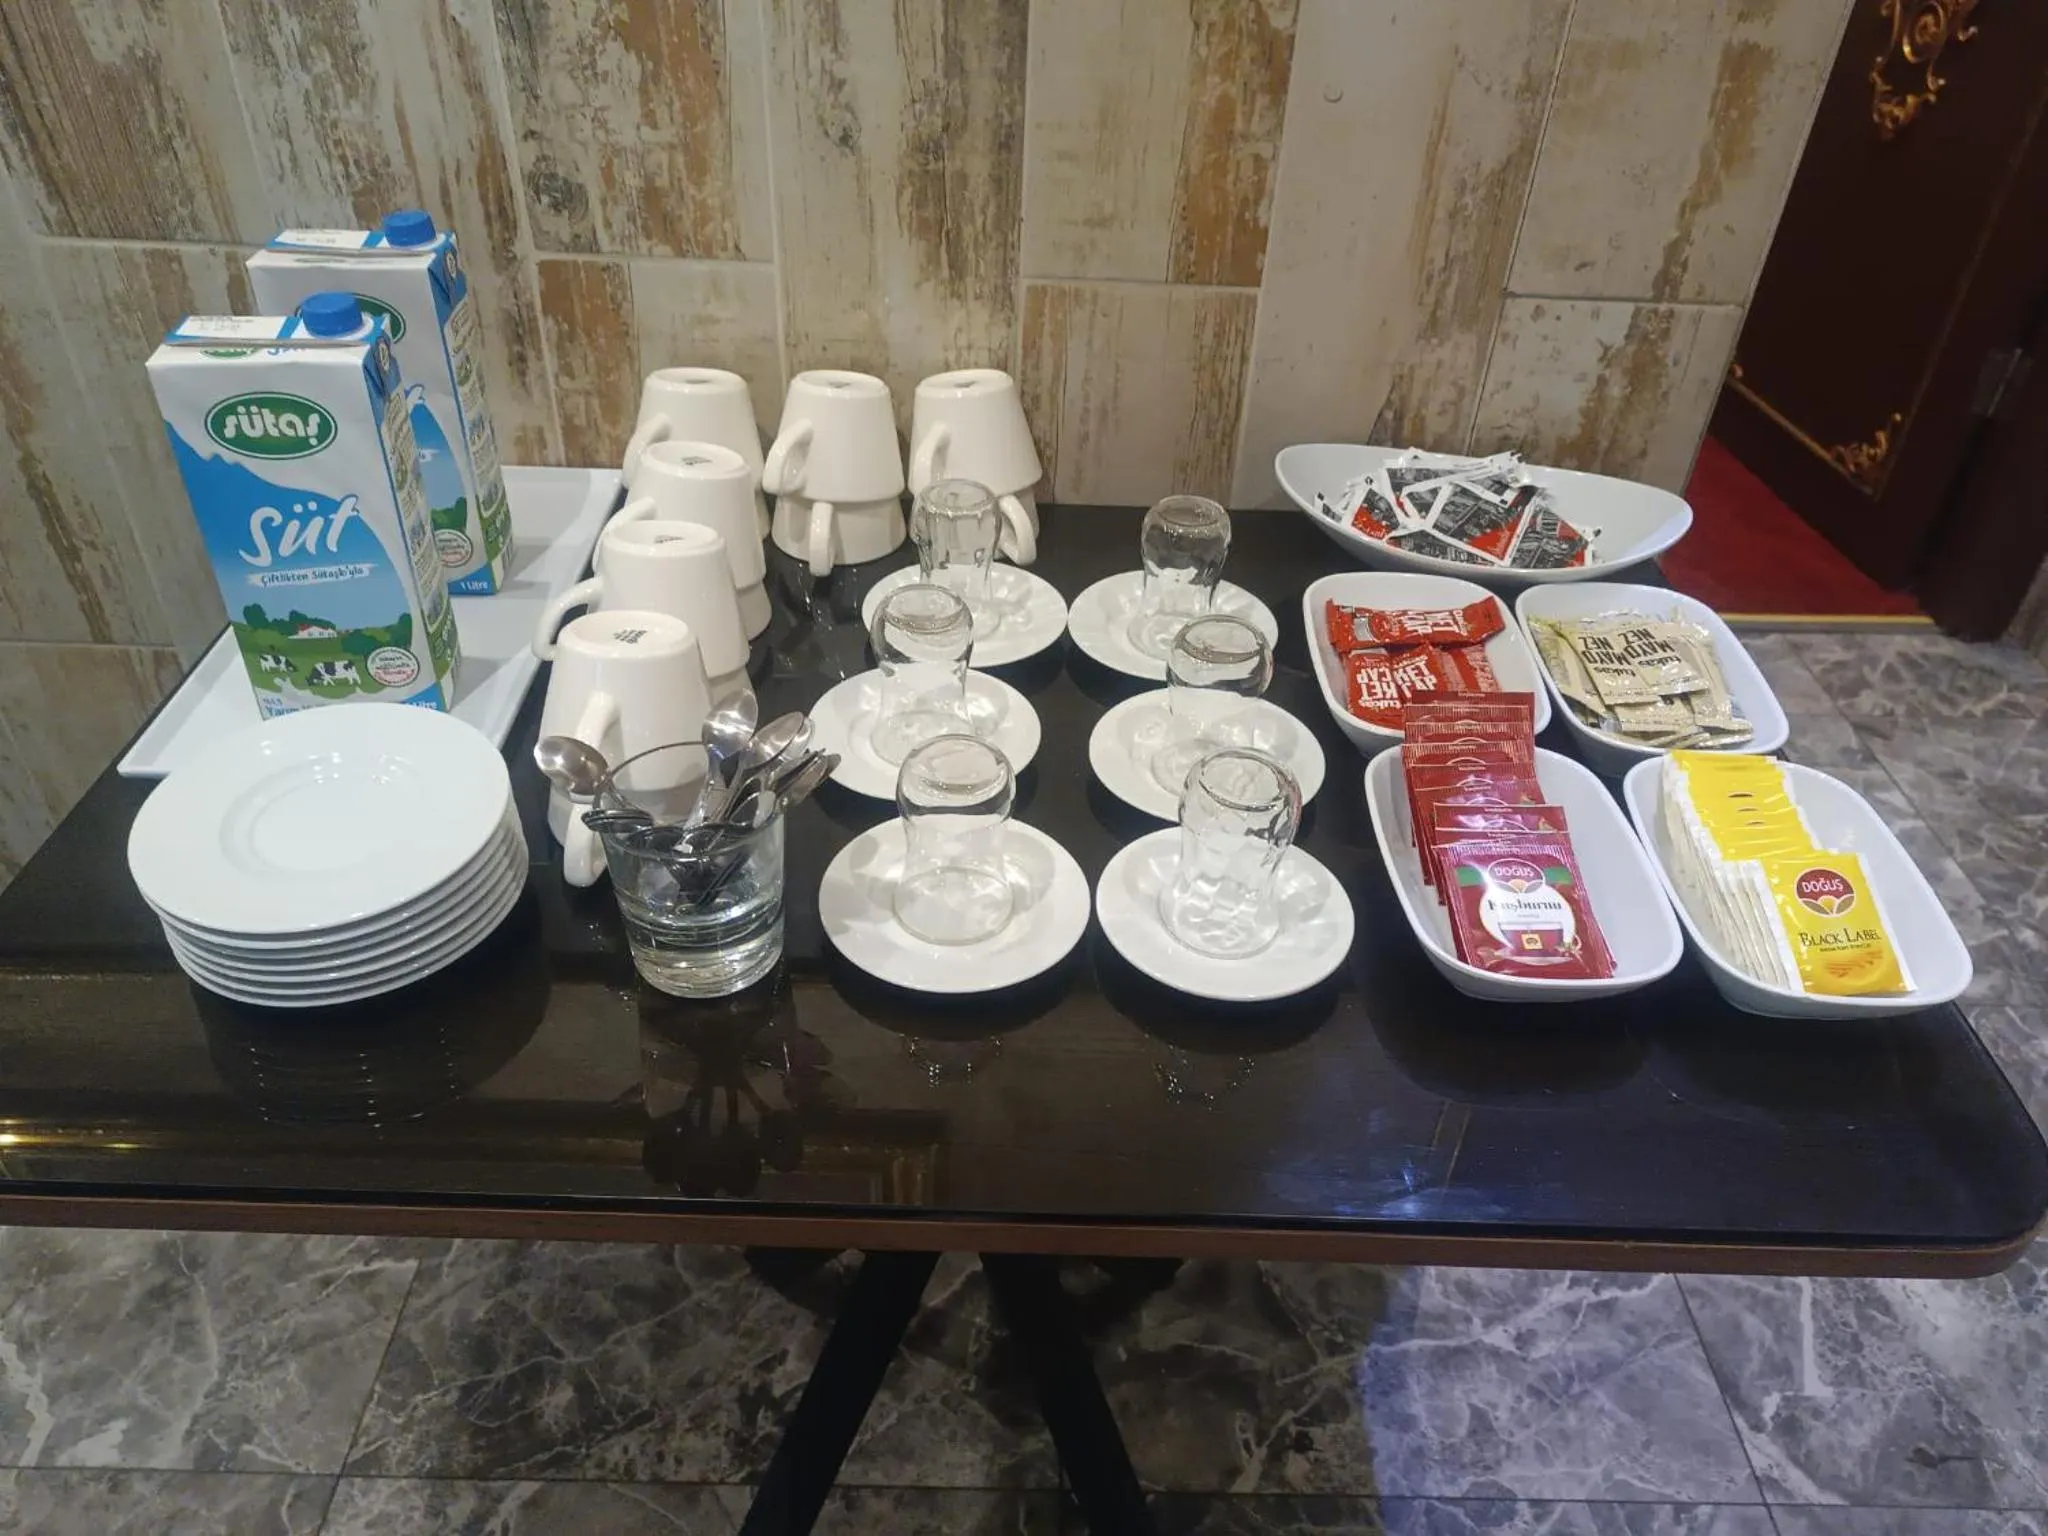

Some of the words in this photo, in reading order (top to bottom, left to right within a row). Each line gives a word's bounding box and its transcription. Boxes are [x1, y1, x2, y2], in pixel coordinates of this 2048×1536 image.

[224, 405, 320, 446] sütaş
[238, 495, 359, 567] Süt
[467, 581, 488, 590] Litre
[1577, 636, 1615, 651] NEZ
[1618, 627, 1656, 646] NEZ
[1581, 651, 1632, 666] MAYO
[1623, 640, 1676, 660] MAYO
[1356, 667, 1392, 684] CAP
[1360, 680, 1399, 699] KET
[1802, 877, 1844, 893] DOĞUŞ
[1799, 931, 1843, 947] BLACK
[1844, 927, 1882, 943] LABEL
